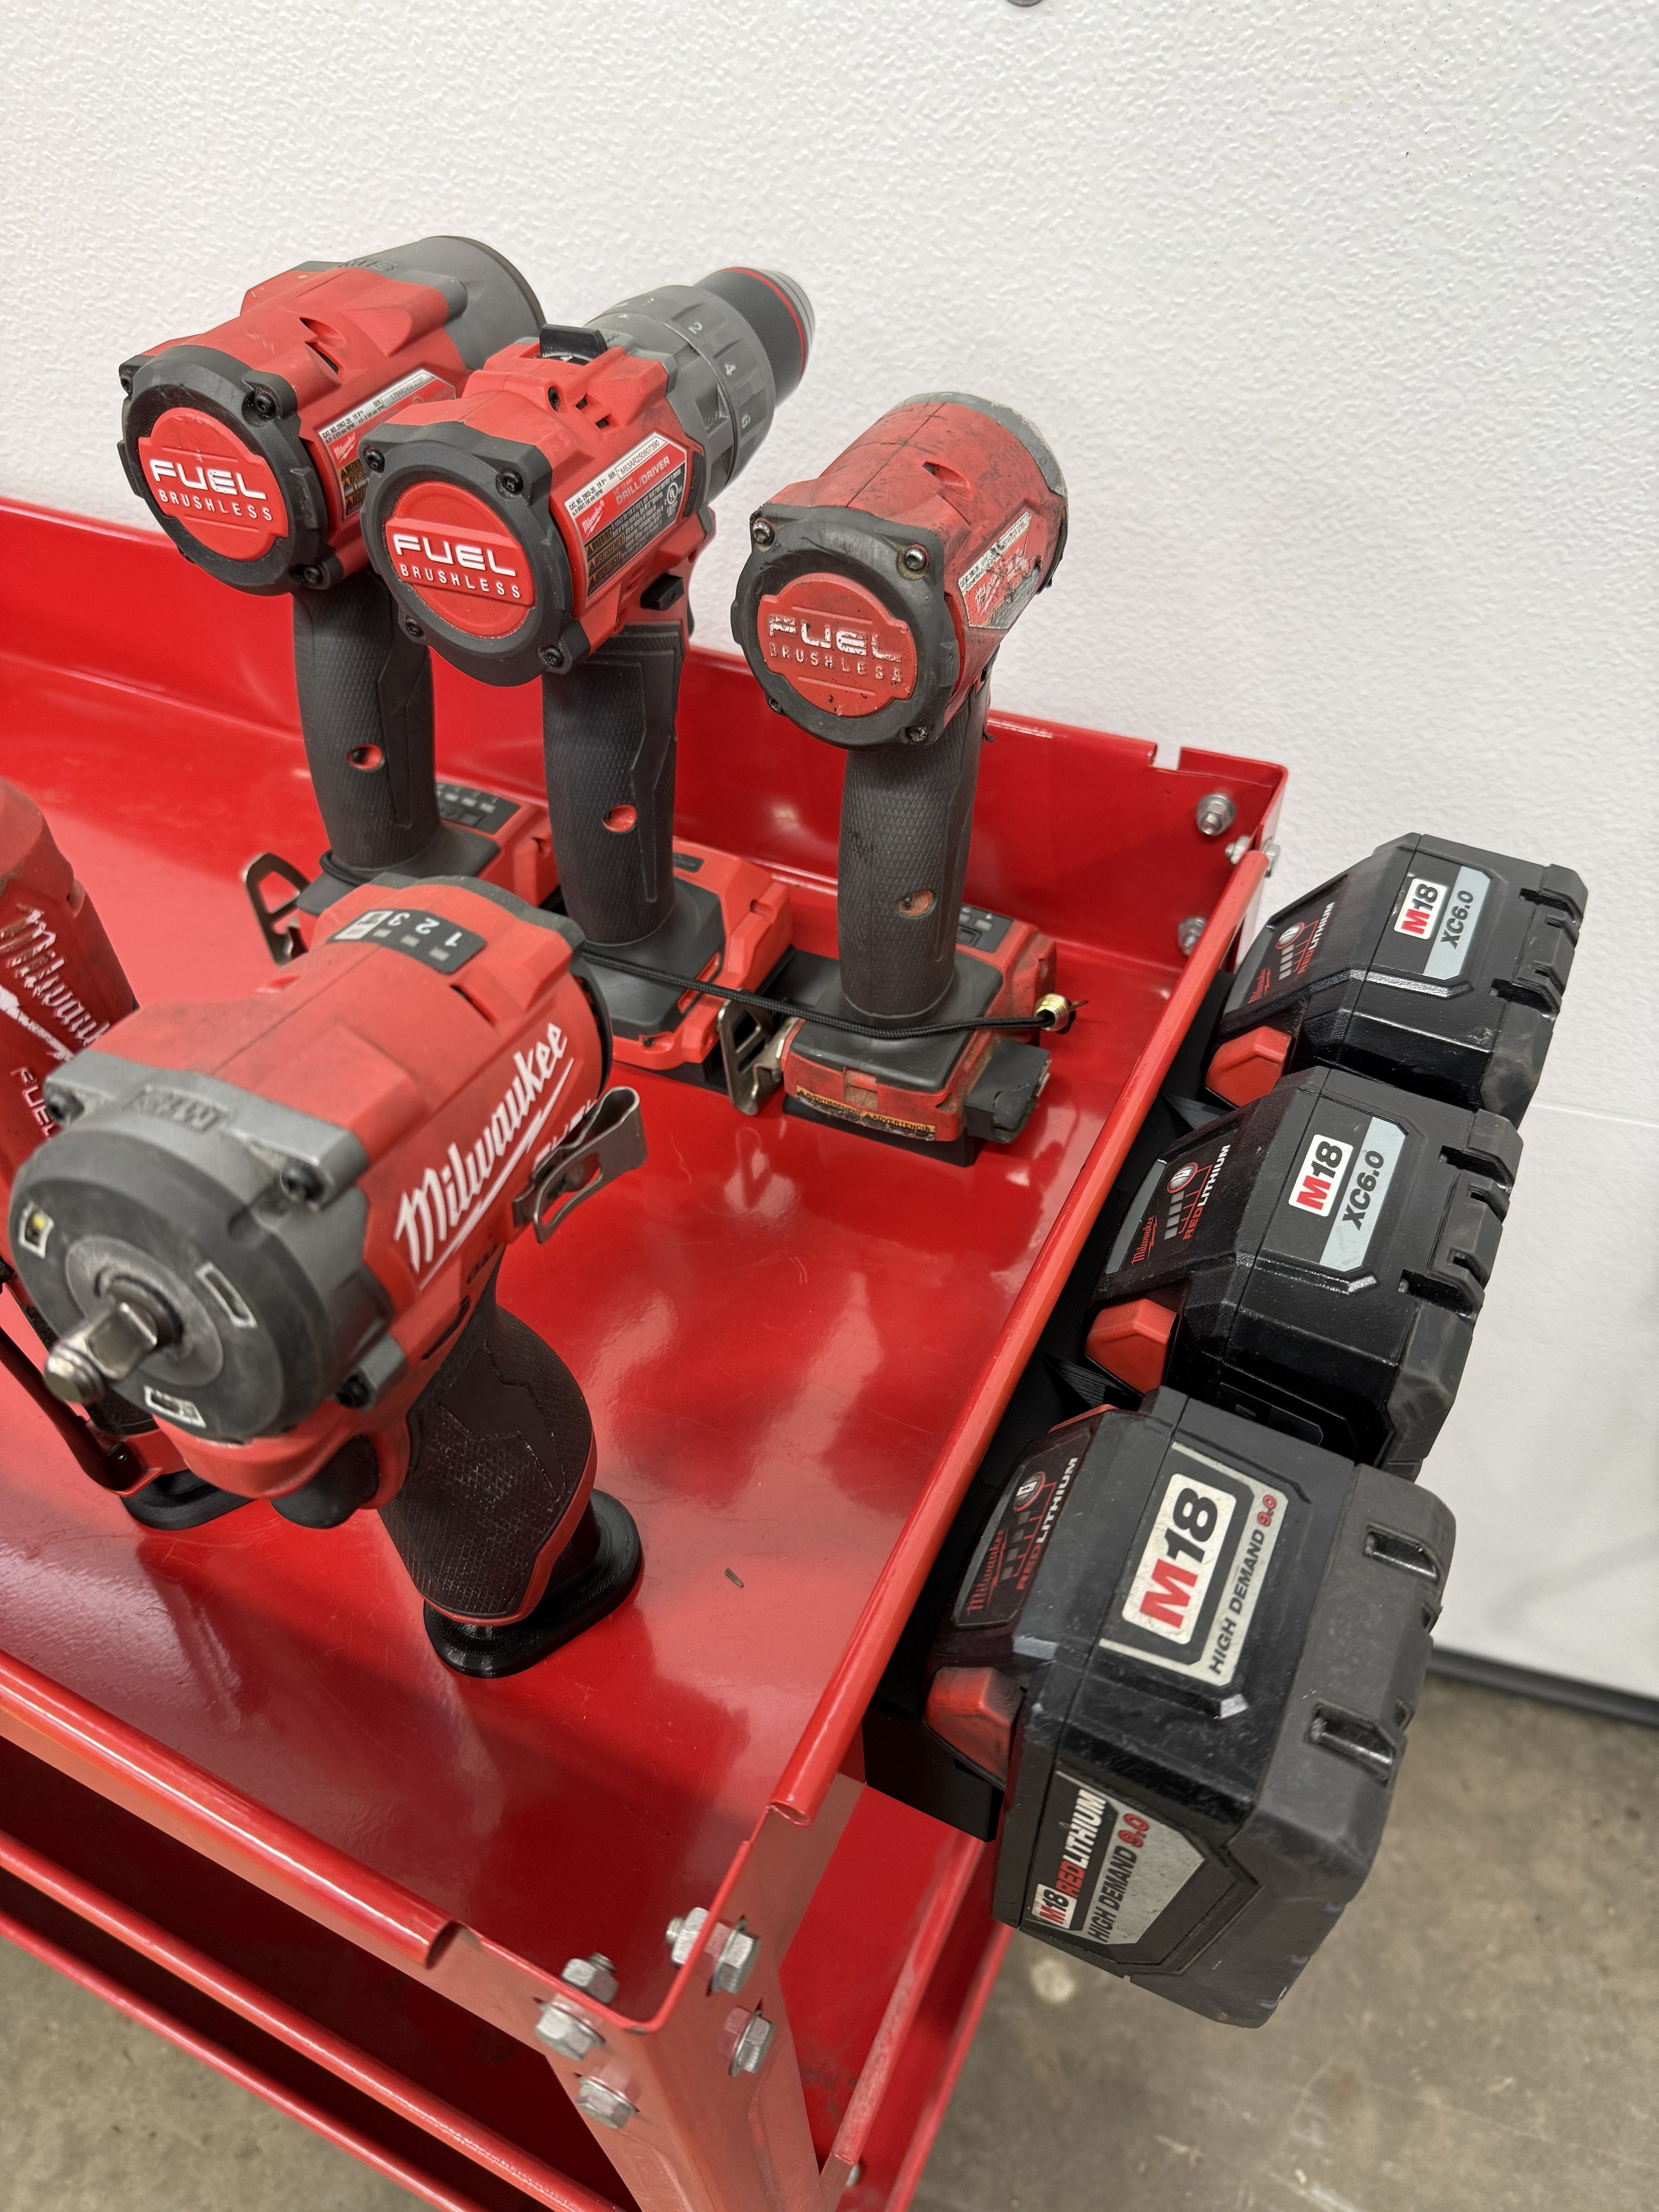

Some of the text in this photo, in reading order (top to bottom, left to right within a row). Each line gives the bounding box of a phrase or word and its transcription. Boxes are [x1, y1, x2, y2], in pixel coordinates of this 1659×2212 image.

[688, 322, 703, 334] 2
[724, 363, 736, 376] 4
[150, 459, 266, 500] FUEL
[158, 489, 272, 521] BRUSHLESS
[616, 456, 670, 505] DRILL/DRIVER
[393, 534, 516, 576] FUEL
[401, 564, 521, 599] BRUSHLESS
[768, 615, 902, 663] FUEL
[769, 642, 903, 683] BRUSHLESS
[388, 912, 462, 947] 1 2 3
[1401, 883, 1438, 935] M18
[1440, 890, 1474, 950] XC6.0
[1298, 902, 1335, 975] REDLITHIUM
[1248, 968, 1268, 1004] Milwaukee
[394, 1023, 567, 1274] Milwaukee
[873, 1115, 931, 1132] ADVERTENCIA
[1183, 1144, 1231, 1241] REDLITHIUM
[1296, 1141, 1343, 1211] M18
[1342, 1150, 1385, 1231] XC6.0
[1131, 1215, 1155, 1265] Milwaukee
[1016, 1457, 1078, 1590] REDLITHIUM
[966, 1527, 1005, 1617] Milwaukee
[1139, 1487, 1218, 1629] M18
[1208, 1495, 1277, 1675] HIGH DEMAND 9.0
[1039, 1788, 1107, 1925] M18 REDLITHIUM
[1088, 1813, 1149, 1943] HIGH DEMAND 9.0
